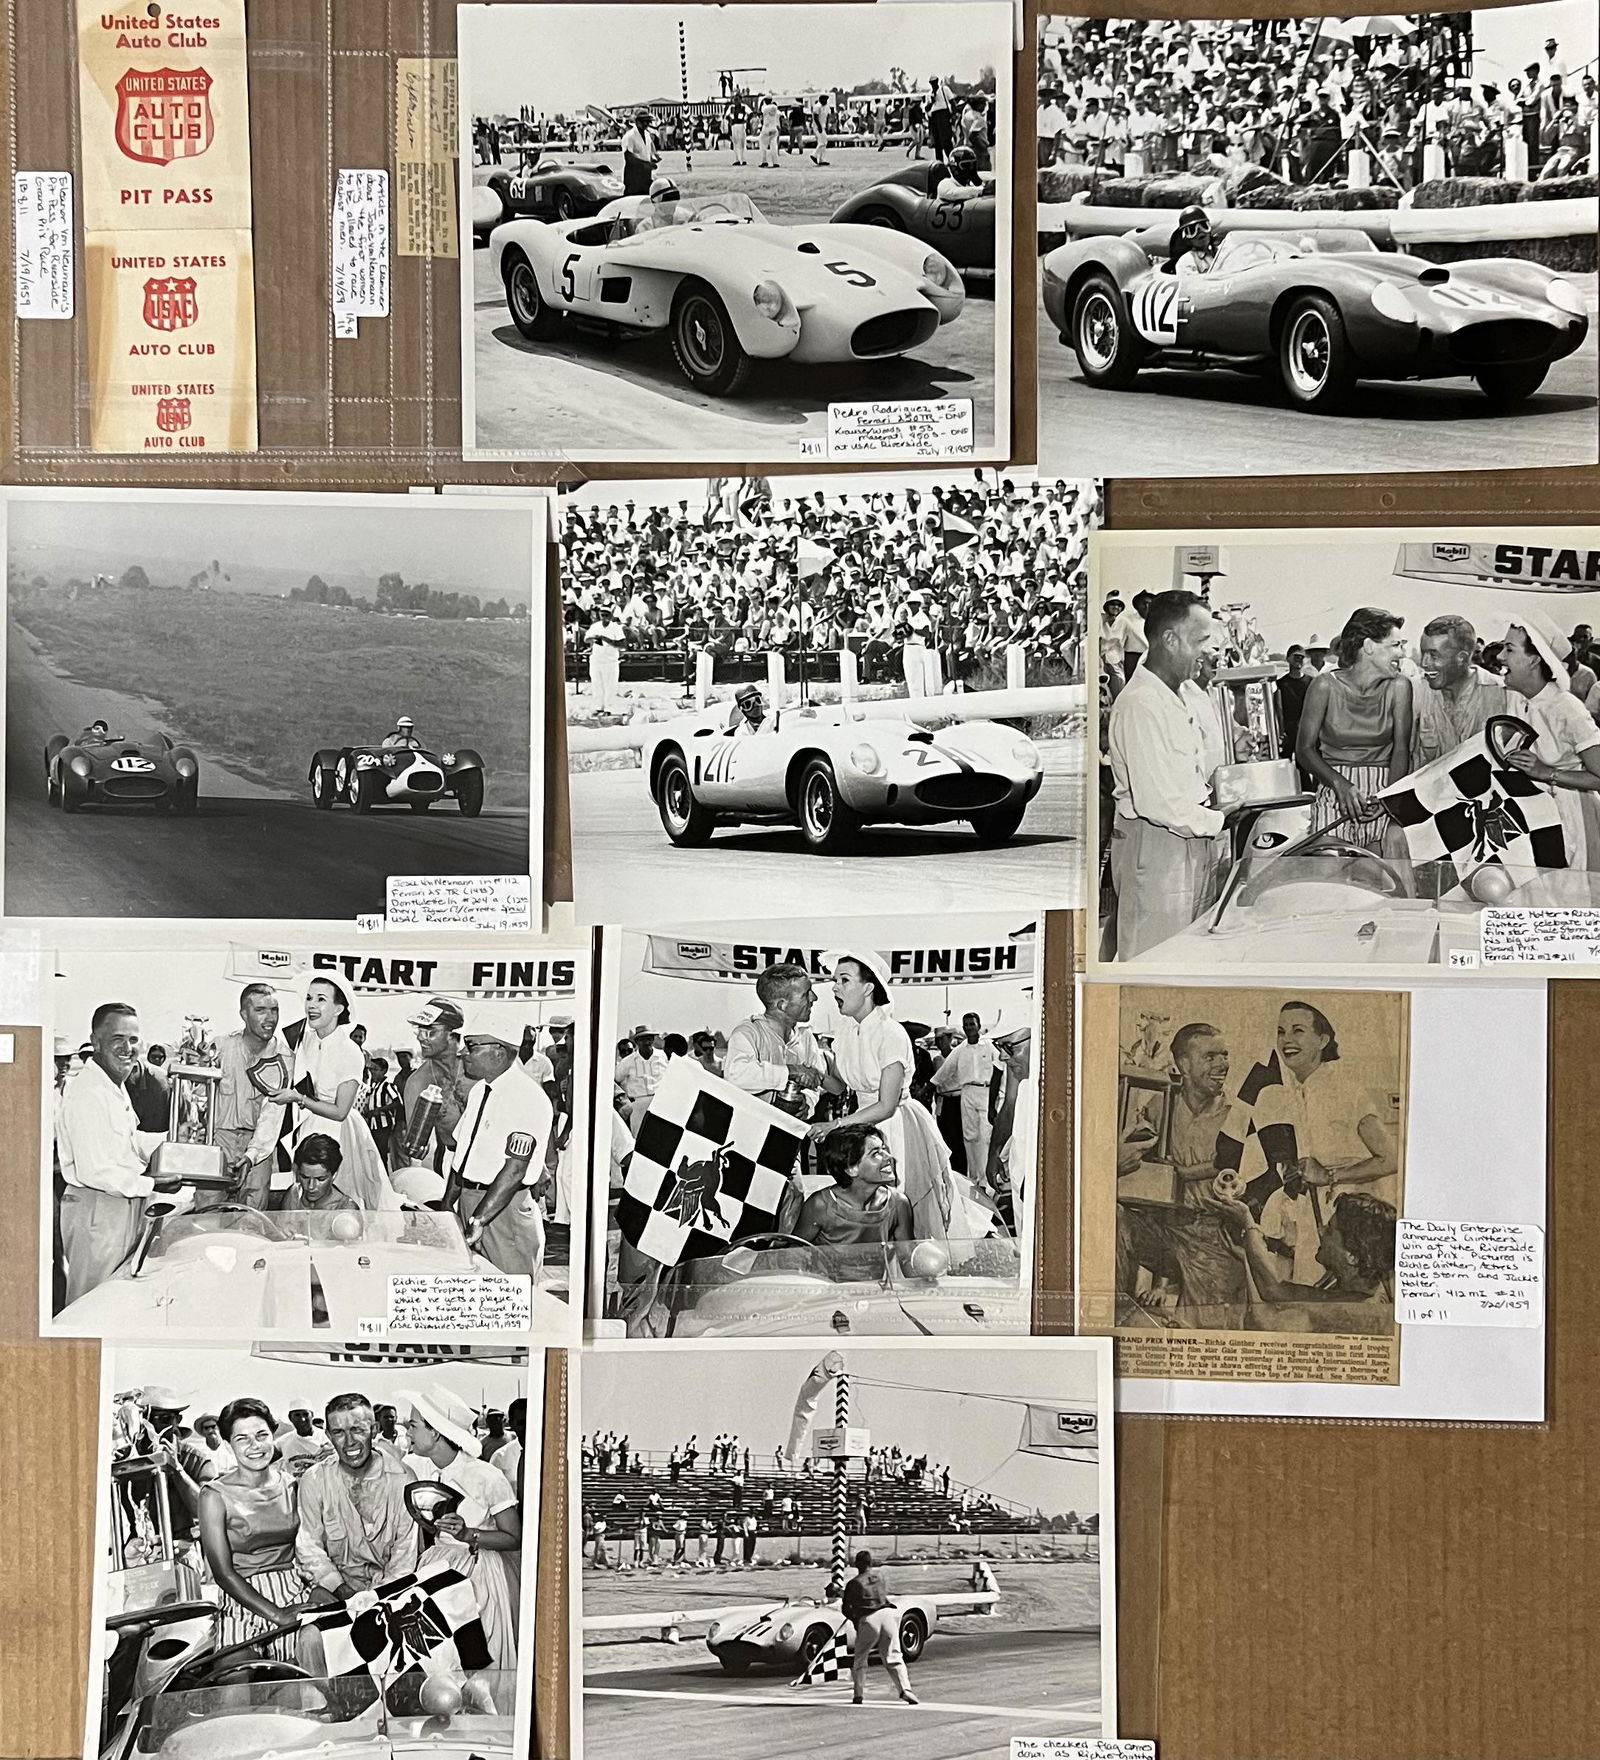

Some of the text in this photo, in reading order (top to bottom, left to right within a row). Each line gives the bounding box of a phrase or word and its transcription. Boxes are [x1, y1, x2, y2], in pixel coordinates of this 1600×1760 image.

[101, 14, 220, 30] United States
[116, 32, 207, 48] Auto Club
[125, 76, 206, 92] UNITED STATES
[134, 102, 202, 119] AUTO
[134, 123, 201, 140] CLUB
[356, 173, 366, 204] being
[509, 177, 527, 200] 69
[59, 176, 68, 224] Eleanor
[121, 188, 213, 204] PIT PASS
[378, 174, 386, 218] Article
[357, 208, 365, 230] the
[931, 201, 965, 231] 53
[38, 218, 49, 240] Prix
[49, 177, 60, 309] Pit Pass for Riverside
[111, 255, 226, 268] UNITED STATES
[561, 253, 582, 303] 5
[823, 261, 877, 288] 5
[379, 264, 388, 312] Examiner
[151, 299, 192, 319] USAC
[1141, 279, 1177, 334] 112
[129, 343, 215, 356] AUTO CLUB
[132, 383, 215, 396] UNITED STATES
[833, 404, 932, 419] Pedro Rodriguez
[857, 416, 891, 425] Ferrari
[144, 435, 206, 448] AUTO CLUB
[880, 439, 933, 448] Riverside
[917, 447, 941, 456] July
[1436, 544, 1467, 556] Mobil
[117, 758, 153, 770] 112
[1487, 910, 1526, 920] Jackie
[1508, 928, 1530, 936] star
[1506, 935, 1523, 946] big
[261, 953, 289, 963] Mobil
[891, 945, 1018, 974] FINISH
[1399, 1221, 1523, 1235] The Daily Enterprise
[1402, 1233, 1457, 1242] announces
[1426, 1243, 1537, 1253] at the Riverside
[1401, 1252, 1534, 1262] Grand Pictured is
[1398, 1260, 1431, 1269] Richie
[392, 1277, 428, 1287] Richie
[434, 1276, 477, 1285] Ginther
[1399, 1271, 1429, 1279] Gale
[1432, 1271, 1470, 1279] Storm
[1504, 1273, 1540, 1283] Jackie
[430, 1286, 465, 1296] Trophy
[498, 1286, 523, 1296] help
[1400, 1288, 1467, 1299] Ferrari 412
[479, 1295, 514, 1306] plaque
[411, 1313, 457, 1322] Riverside
[1408, 1309, 1448, 1321] 11 of 11
[1062, 1416, 1094, 1427] Mobil
[1014, 1739, 1039, 1749] The
[1043, 1740, 1089, 1750] checked
[1055, 1750, 1070, 1758] as
